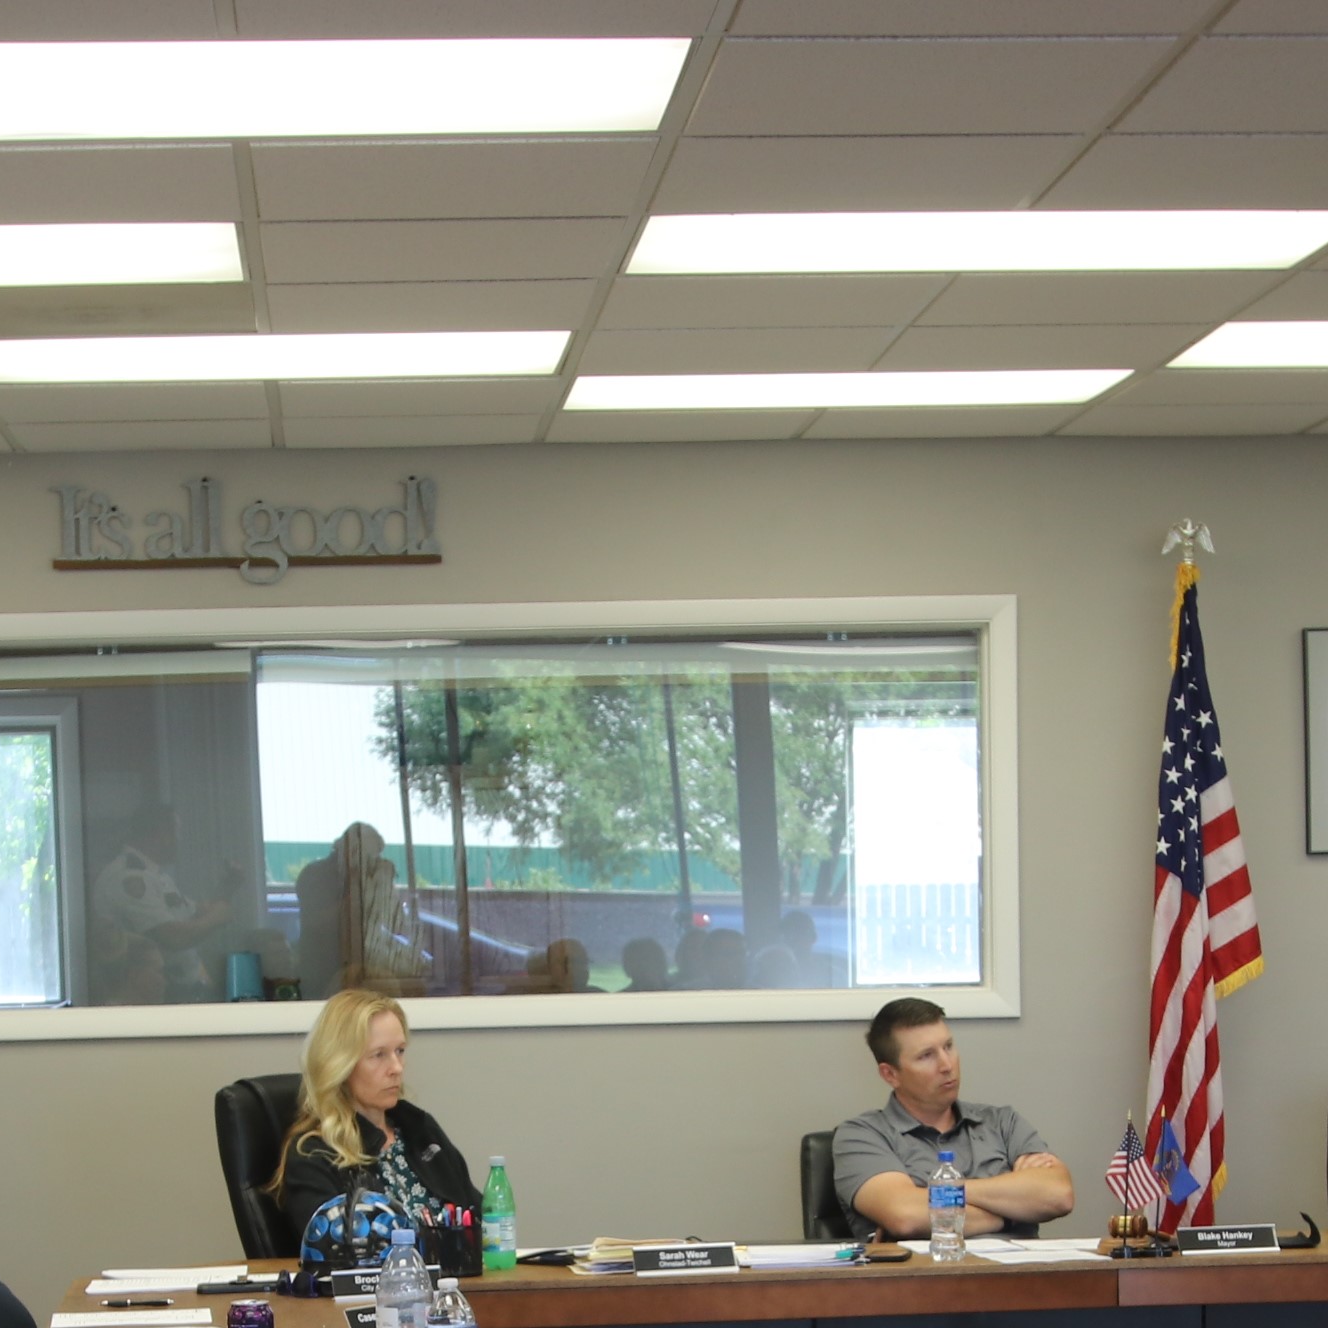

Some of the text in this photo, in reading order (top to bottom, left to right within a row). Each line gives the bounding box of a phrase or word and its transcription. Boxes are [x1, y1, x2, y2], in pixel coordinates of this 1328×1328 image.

[48, 475, 440, 586] It's all good!
[1197, 1231, 1253, 1241] Blake Hankey
[659, 1250, 708, 1260] Sarah Wear
[361, 1284, 374, 1292] City
